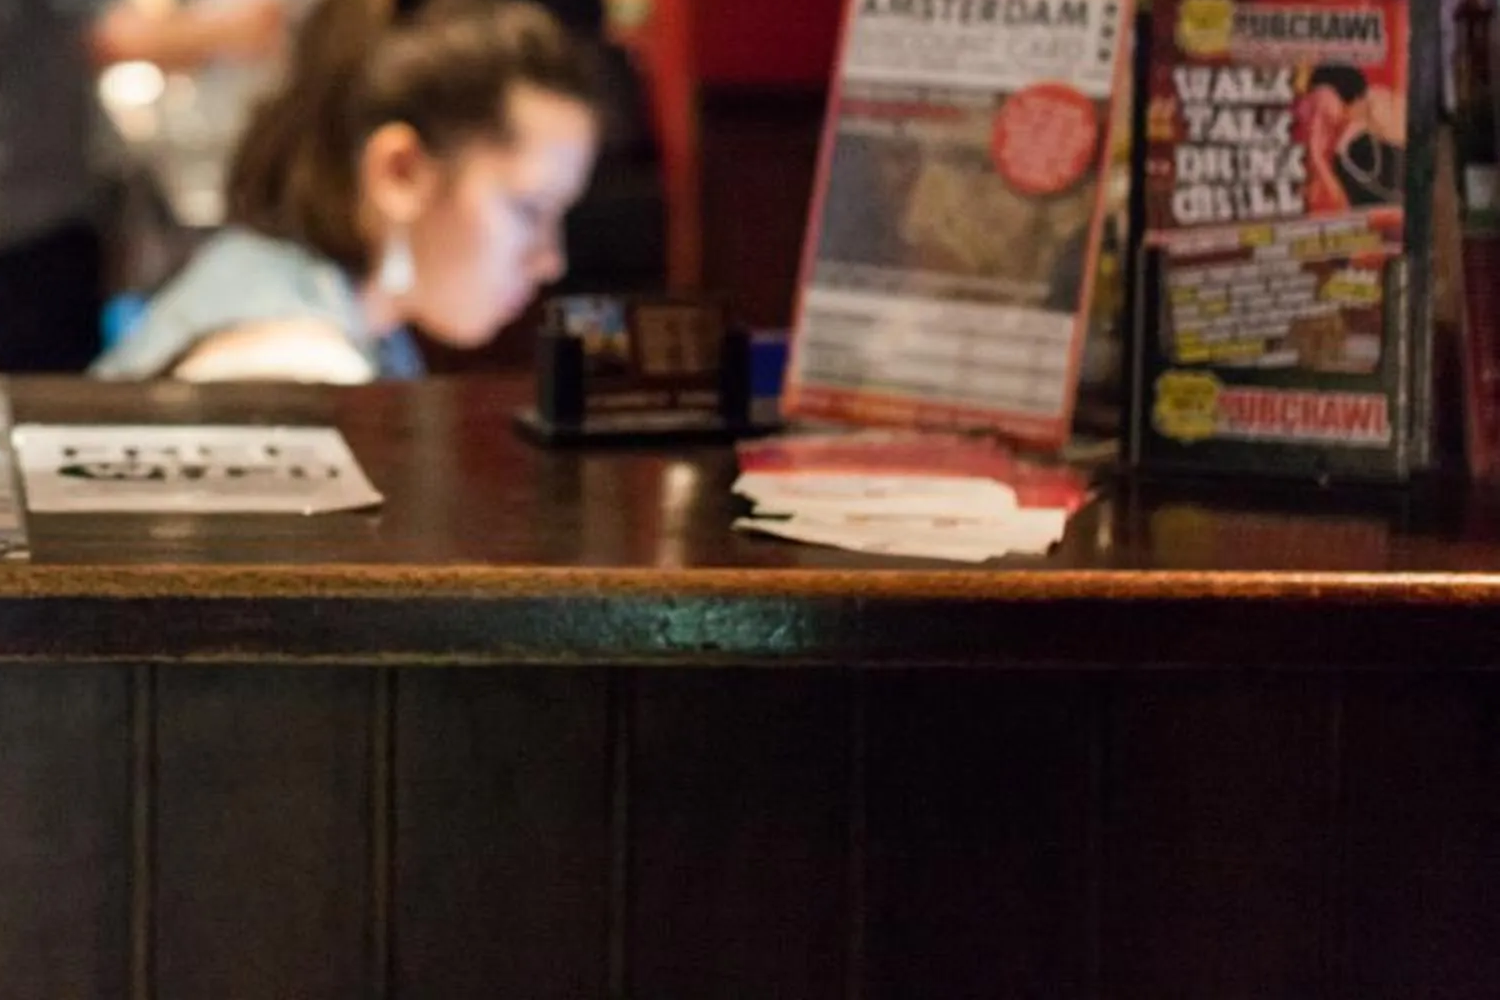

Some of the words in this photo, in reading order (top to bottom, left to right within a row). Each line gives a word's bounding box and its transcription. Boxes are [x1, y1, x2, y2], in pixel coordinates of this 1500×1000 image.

[1173, 65, 1294, 104] WALK
[1184, 104, 1293, 146] TALK
[1176, 145, 1307, 184] DRINK
